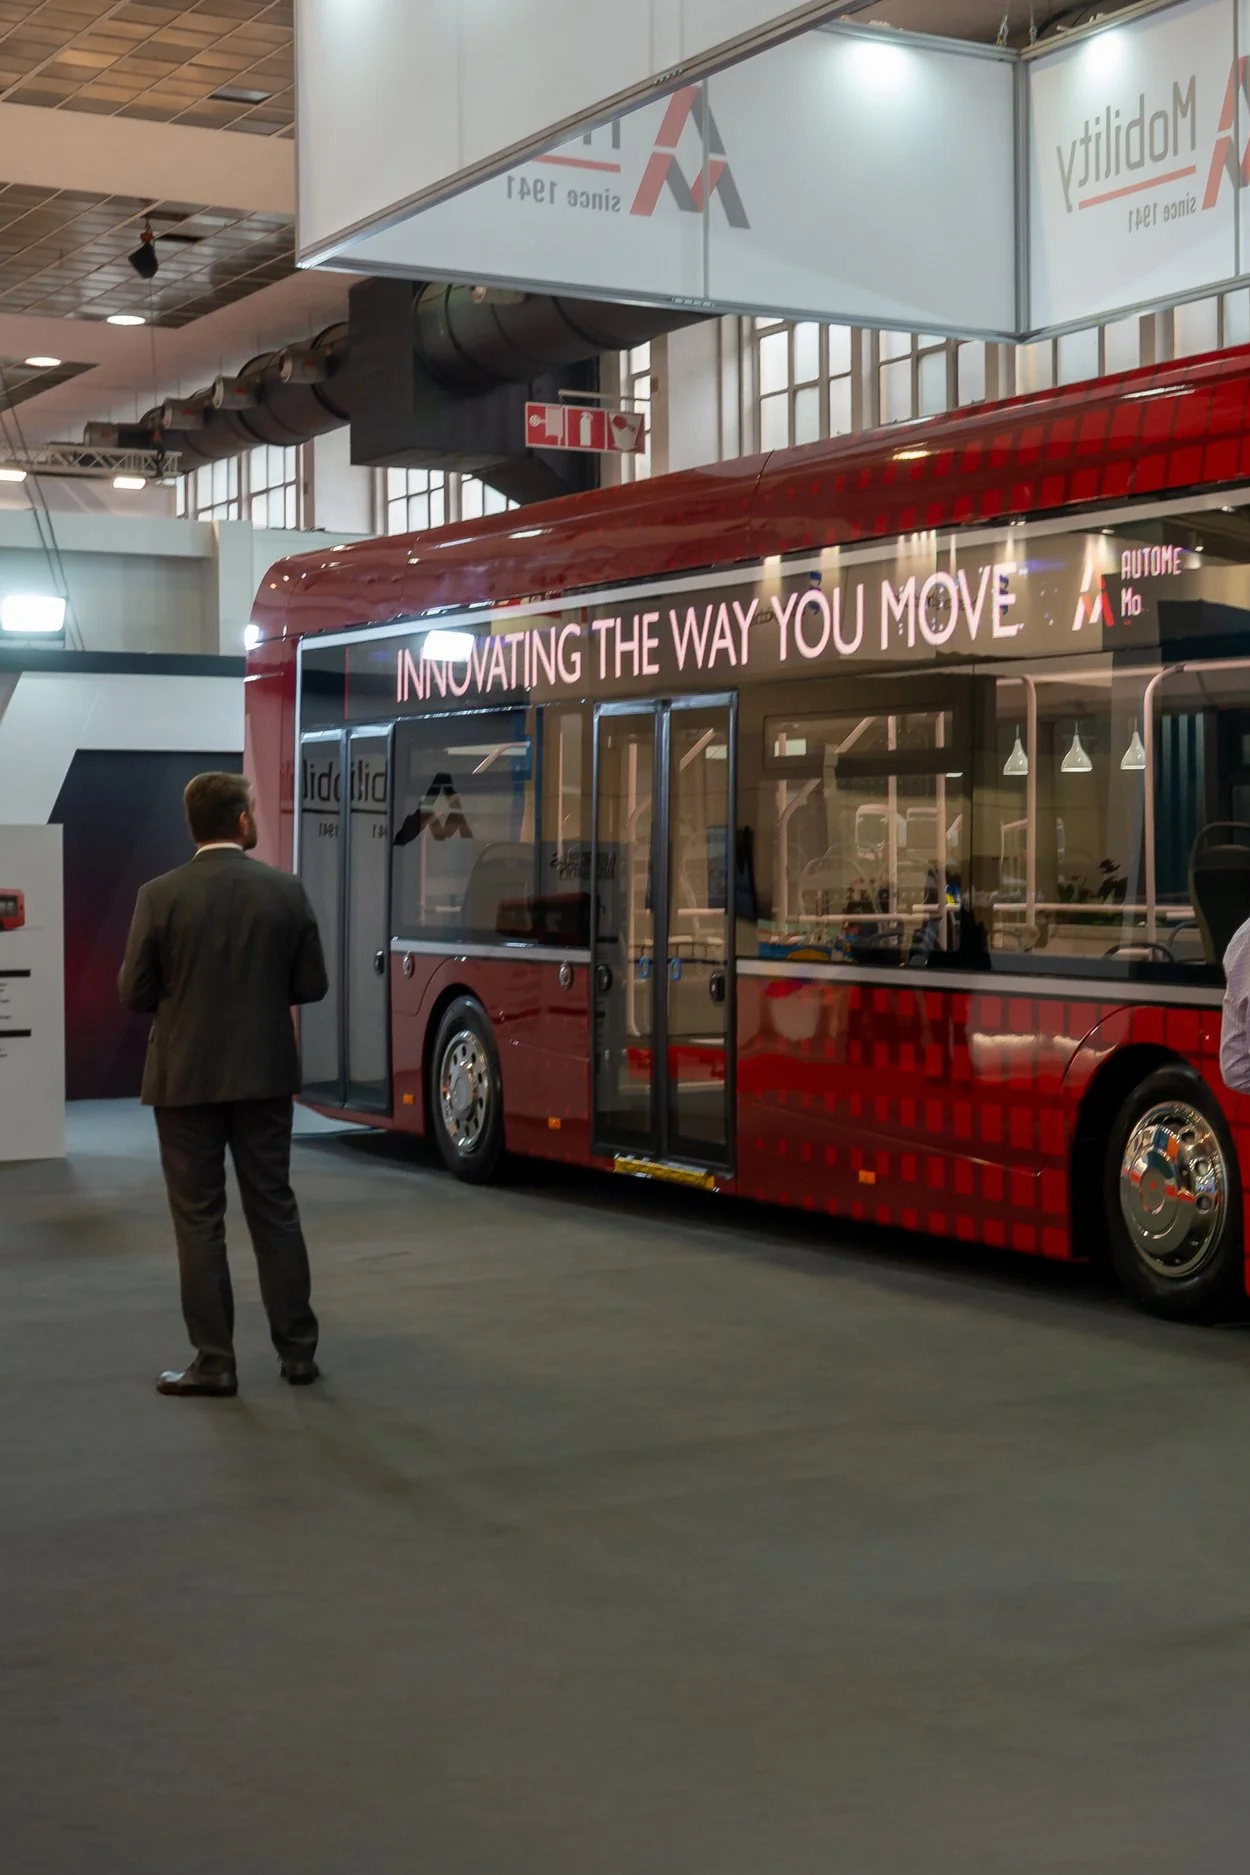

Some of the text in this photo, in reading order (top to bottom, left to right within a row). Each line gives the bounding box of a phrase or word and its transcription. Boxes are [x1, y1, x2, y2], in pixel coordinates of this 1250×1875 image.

[1121, 545, 1182, 580] AUTOME
[397, 561, 1020, 702] INNOVATING THE WAY YOU MOVE
